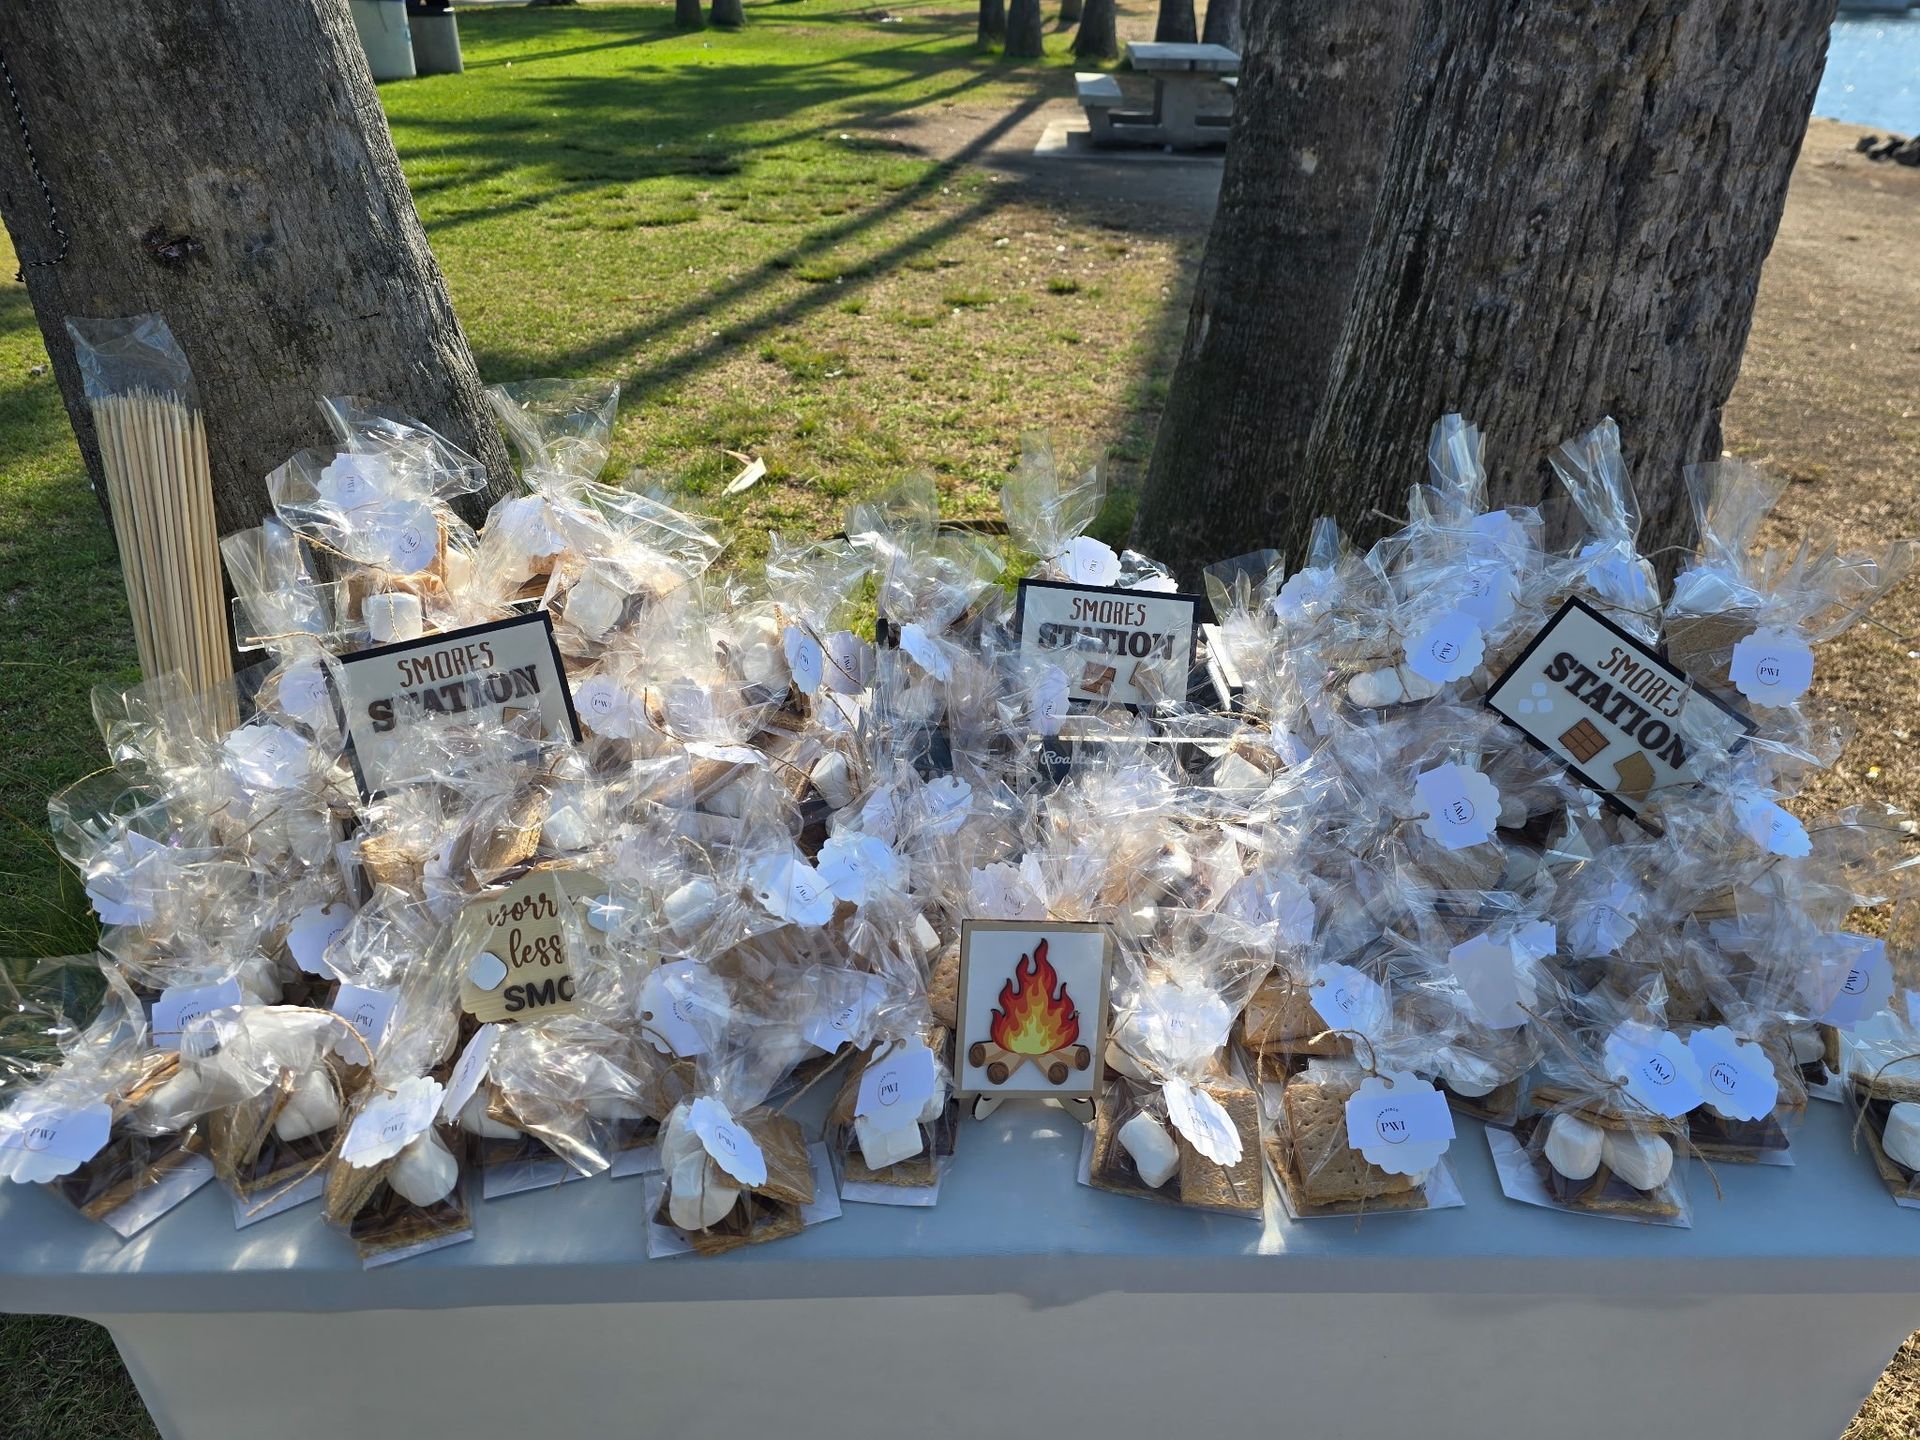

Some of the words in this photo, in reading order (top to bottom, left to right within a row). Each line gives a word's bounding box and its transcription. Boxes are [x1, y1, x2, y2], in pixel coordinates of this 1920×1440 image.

[1069, 597, 1146, 627] SMORES
[1438, 642, 1454, 660] PWI
[397, 641, 494, 688] SMORES
[1760, 666, 1780, 677] PWI
[1597, 647, 1689, 717] SMORES
[368, 664, 541, 733] SATION
[1543, 652, 1687, 769] STATION
[1452, 801, 1467, 821] PWI
[487, 893, 580, 926] worr
[509, 928, 565, 968] less
[1844, 969, 1860, 991] PWI
[355, 1013, 373, 1027] PWI
[1649, 1058, 1671, 1080] PWI
[1714, 1069, 1736, 1089] PWI
[881, 1082, 898, 1096] PWI
[29, 1128, 56, 1141] PWI
[1381, 1120, 1406, 1132] PWI
